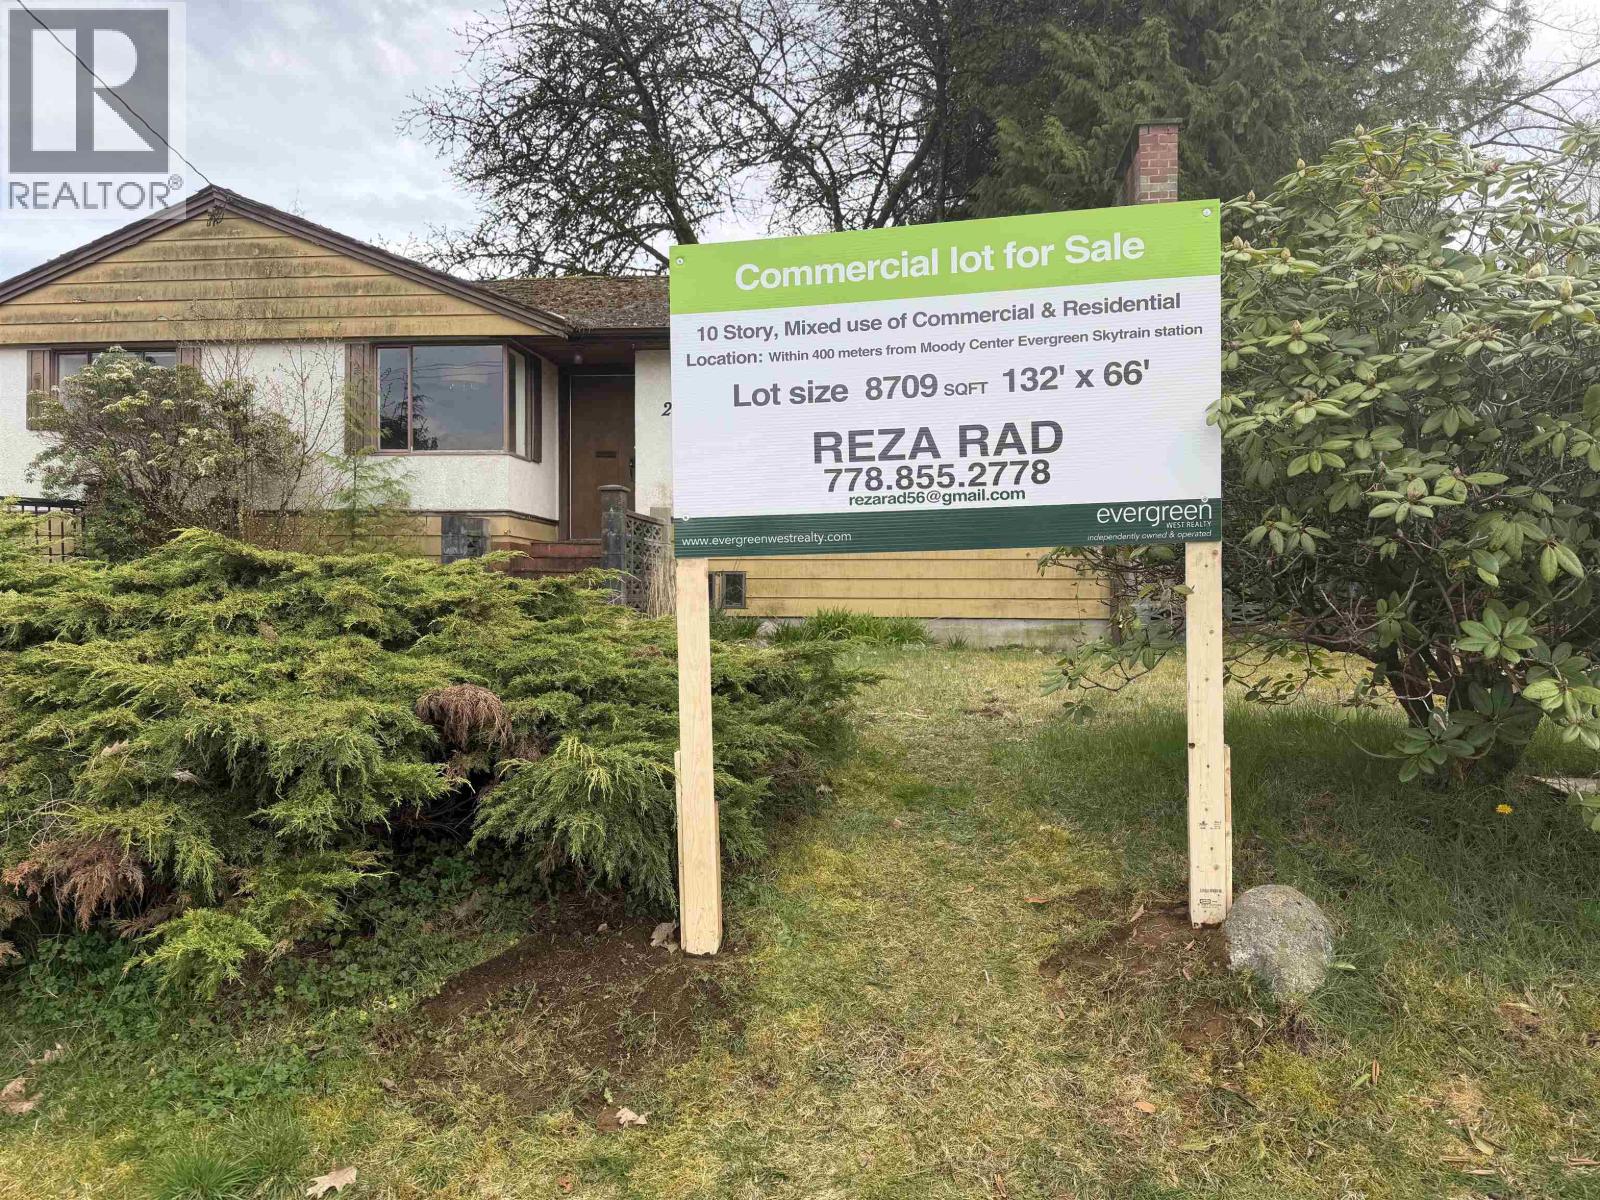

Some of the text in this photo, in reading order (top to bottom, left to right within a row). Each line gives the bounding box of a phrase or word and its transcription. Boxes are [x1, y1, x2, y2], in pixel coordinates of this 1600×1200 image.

[735, 232, 1145, 290] Commercial lot for Sale
[697, 292, 1180, 342] 10 Story, Mixed use of Commercial & Residential
[686, 324, 1203, 367] Location: Within 400 meters from Moody Center Evergreen Skytrain station
[734, 359, 1149, 407] Lot size 8709 SQFT 132' x 66'
[813, 420, 1063, 464] REZA RAD
[824, 459, 1051, 493] 778.855.2778
[849, 487, 1026, 507] rezarad56@gmail.com
[1097, 504, 1212, 527] evergreen
[681, 531, 852, 547] www.evergreenwestrealty.com
[1087, 529, 1212, 542] independently owned & operated
